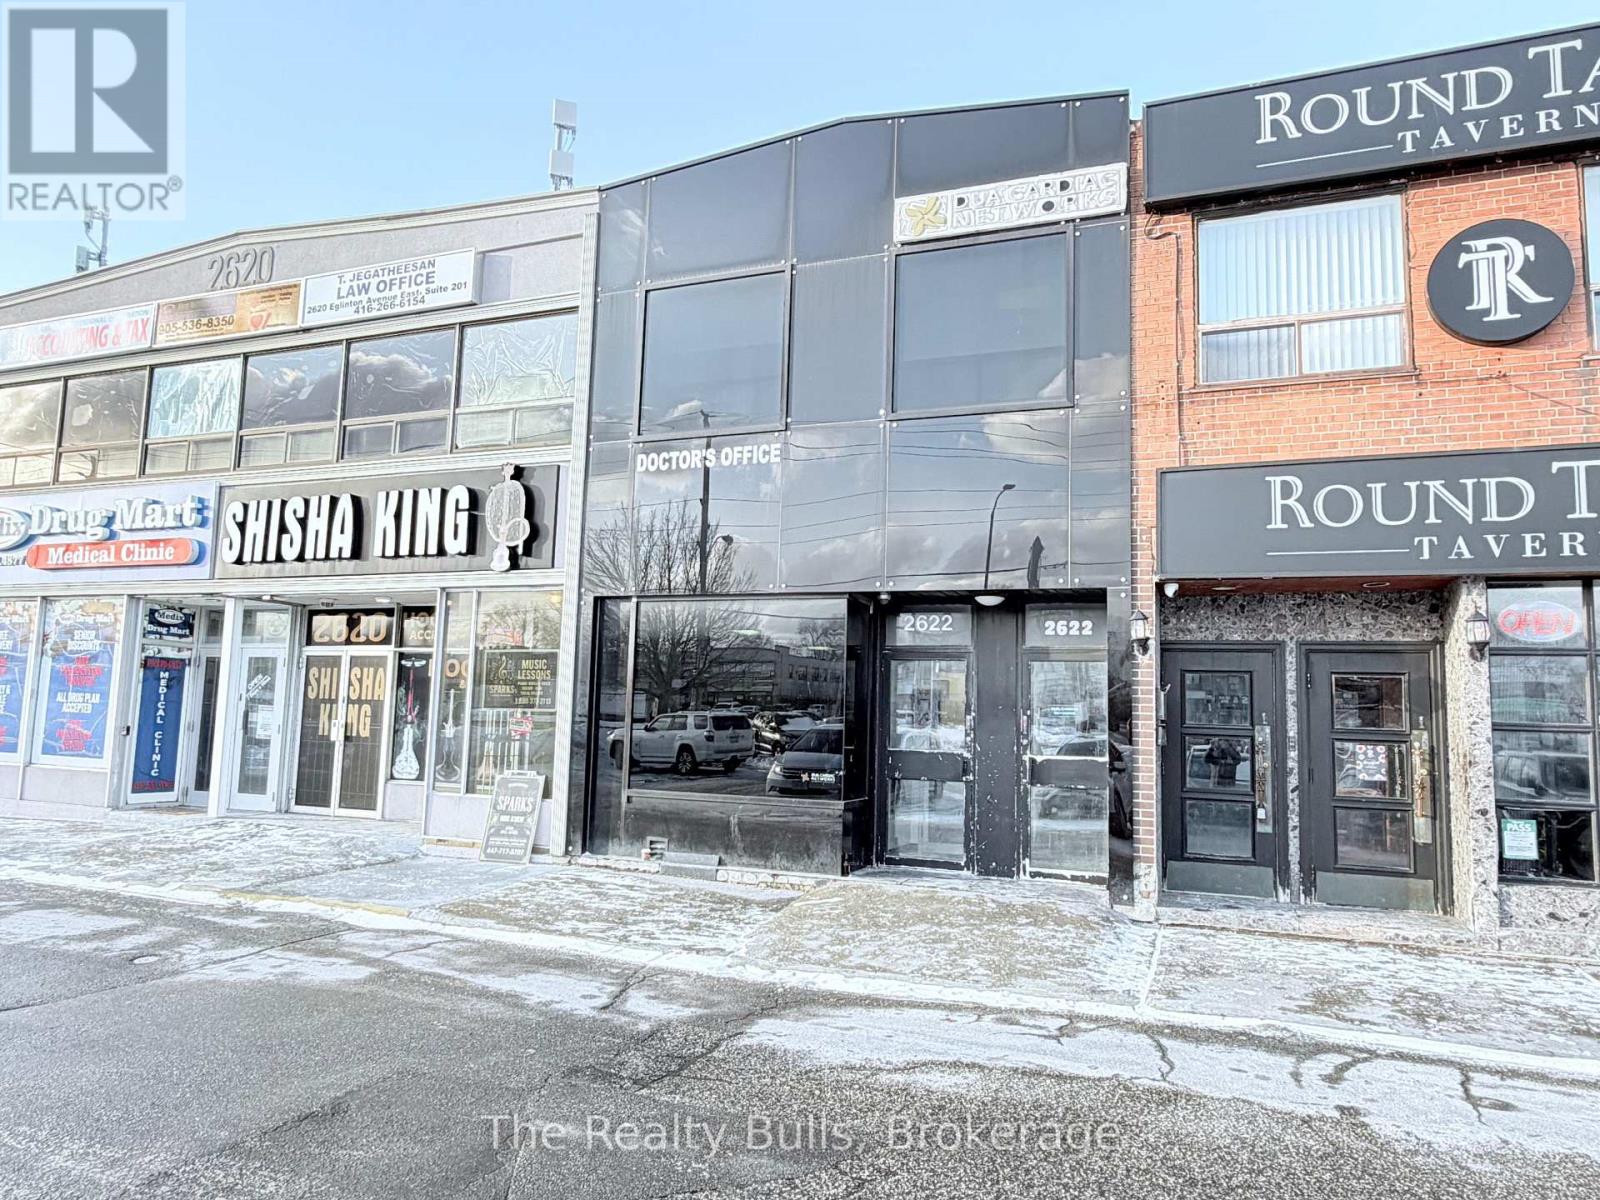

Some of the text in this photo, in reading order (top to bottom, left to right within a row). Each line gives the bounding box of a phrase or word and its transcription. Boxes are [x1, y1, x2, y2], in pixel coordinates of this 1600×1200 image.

[208, 246, 275, 291] 2620
[349, 259, 436, 283] JEGATHEESAN
[307, 304, 328, 315] 2620
[329, 300, 363, 313] Eglinton
[366, 294, 398, 305] Avenue
[425, 285, 449, 295] Suite
[451, 281, 468, 291] 201
[336, 270, 436, 300] LAW OFFICE
[354, 295, 426, 316] 416-266-6154
[636, 443, 781, 473] DOCTOR'S OFFICE
[28, 503, 114, 541] Drug
[114, 495, 203, 531] Mart
[221, 484, 470, 564] SHISHA KING
[47, 545, 115, 565] Medical
[121, 543, 176, 561] Clinic
[1414, 532, 1600, 560] TAVER
[156, 610, 185, 621] Medix
[312, 612, 388, 643] 2620
[903, 615, 953, 631] 2622
[1044, 620, 1093, 636] 2622
[1500, 608, 1575, 636] OPEN
[147, 624, 190, 636] Drug Mart
[517, 670, 551, 681] LESSONS
[521, 659, 548, 670] MUSIC
[156, 671, 170, 724] MEDICAL
[151, 731, 163, 777] CLINIC
[497, 795, 534, 813] SPARKS
[1506, 823, 1532, 832] PASS
